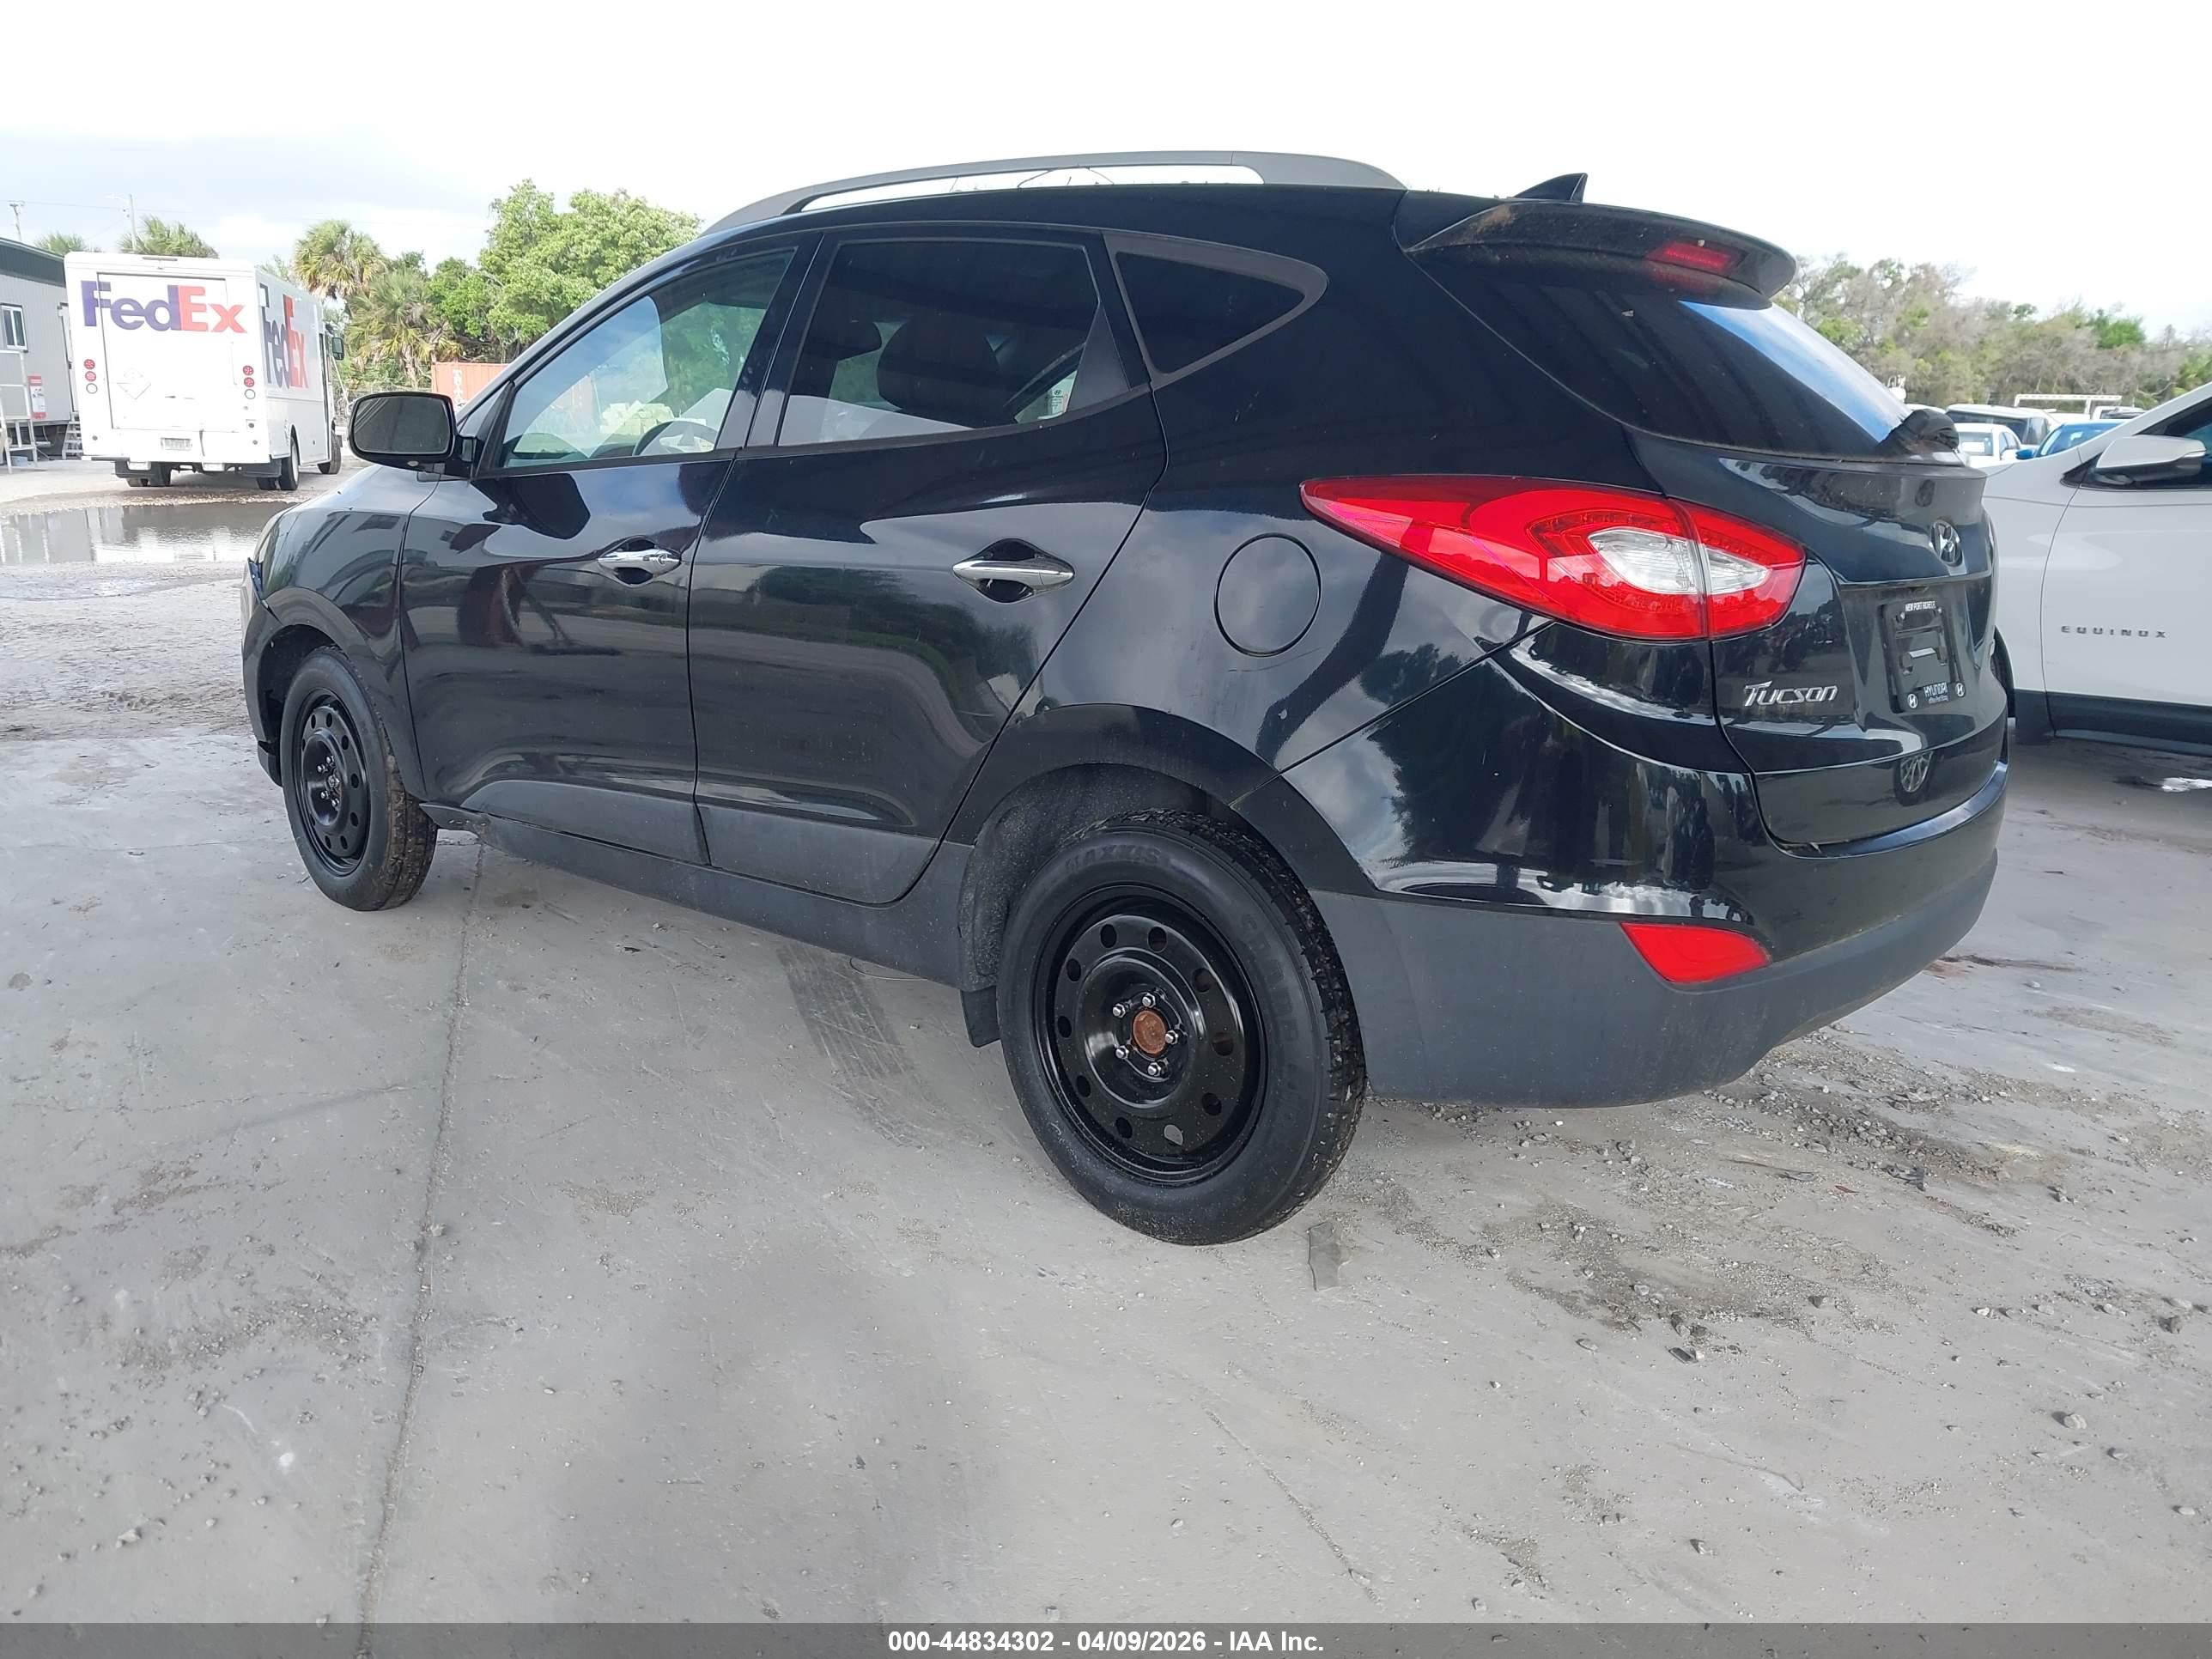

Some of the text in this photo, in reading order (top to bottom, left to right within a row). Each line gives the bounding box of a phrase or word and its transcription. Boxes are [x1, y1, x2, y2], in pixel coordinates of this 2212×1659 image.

[81, 280, 247, 333] FedEx
[259, 283, 308, 389] FedEx
[2061, 625, 2166, 638] EQUINOX
[1744, 680, 1838, 707] Tucson
